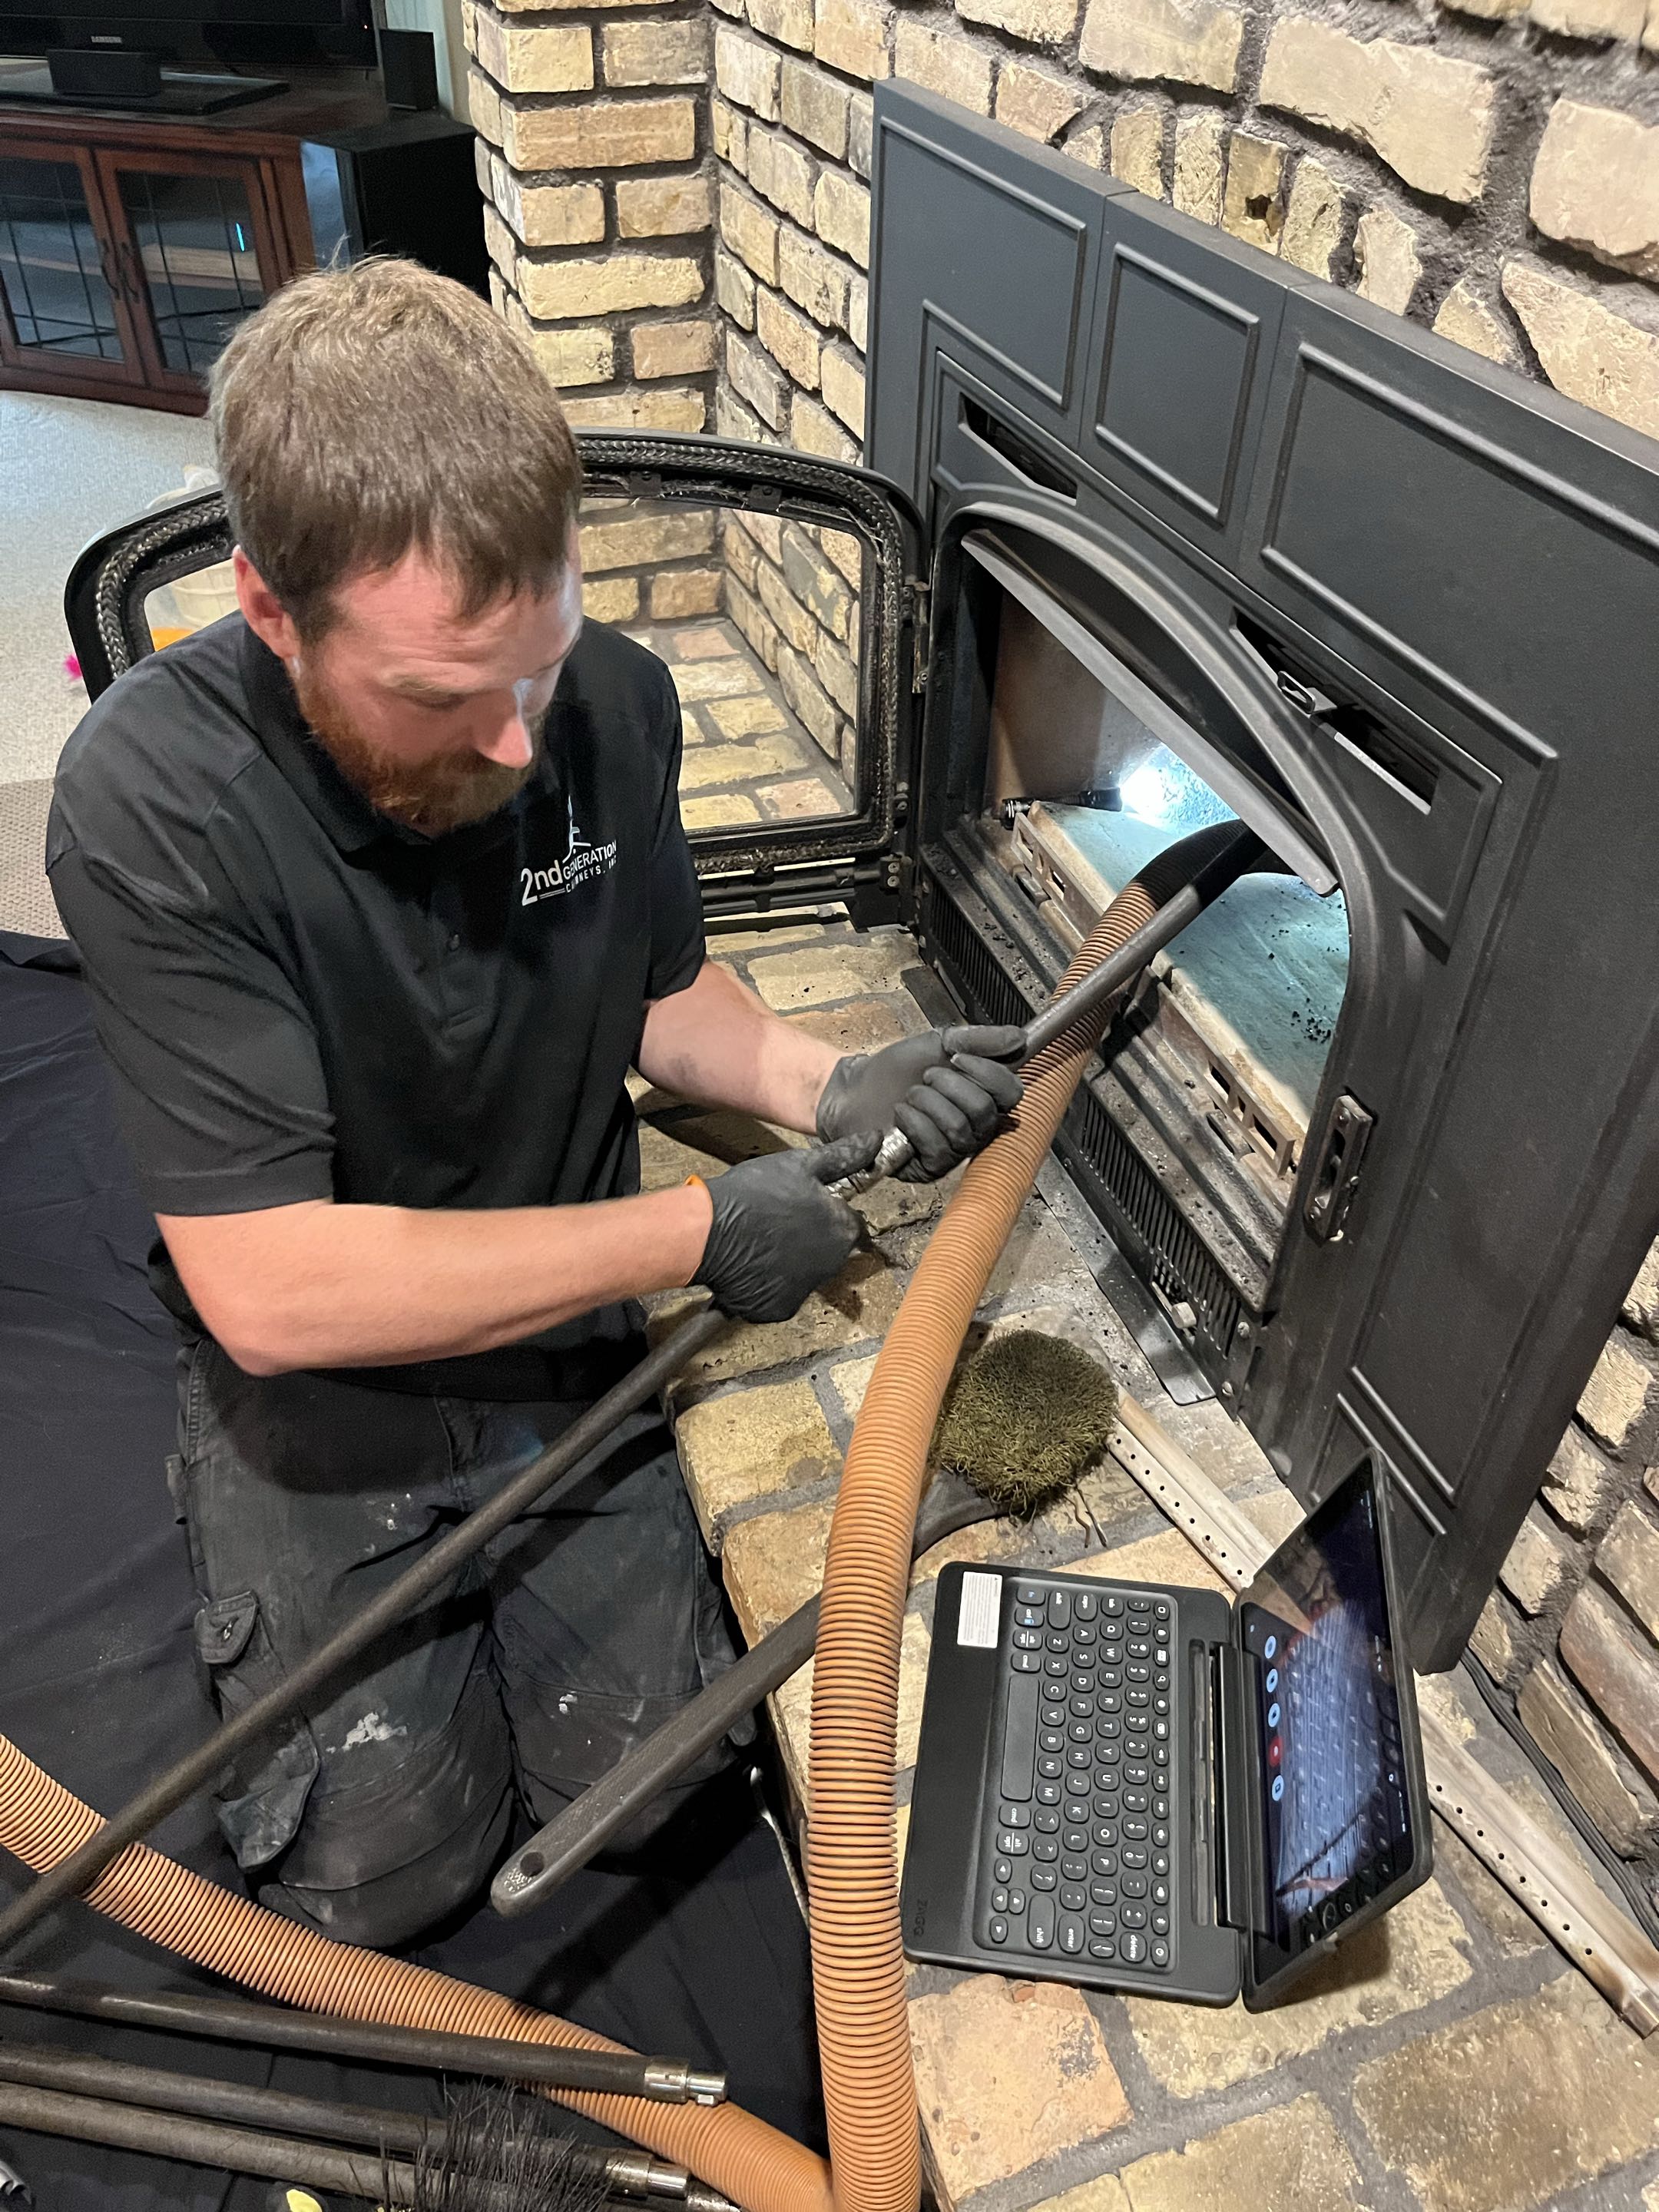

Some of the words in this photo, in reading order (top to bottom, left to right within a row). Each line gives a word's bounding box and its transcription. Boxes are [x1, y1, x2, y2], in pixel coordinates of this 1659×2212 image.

[521, 859, 563, 906] 2nd
[1106, 1647, 1115, 1657] W
[1050, 1685, 1059, 1694] C
[1075, 1726, 1085, 1734] G
[1075, 1752, 1084, 1760] H
[1045, 1761, 1055, 1770] N
[1102, 1774, 1111, 1783] U
[1044, 1787, 1054, 1797] M
[1100, 1828, 1111, 1838] O
[1003, 1836, 1012, 1848] opt
[1014, 1838, 1022, 1848] alt
[1035, 1927, 1045, 1944] shift
[1130, 1934, 1138, 1961] delete
